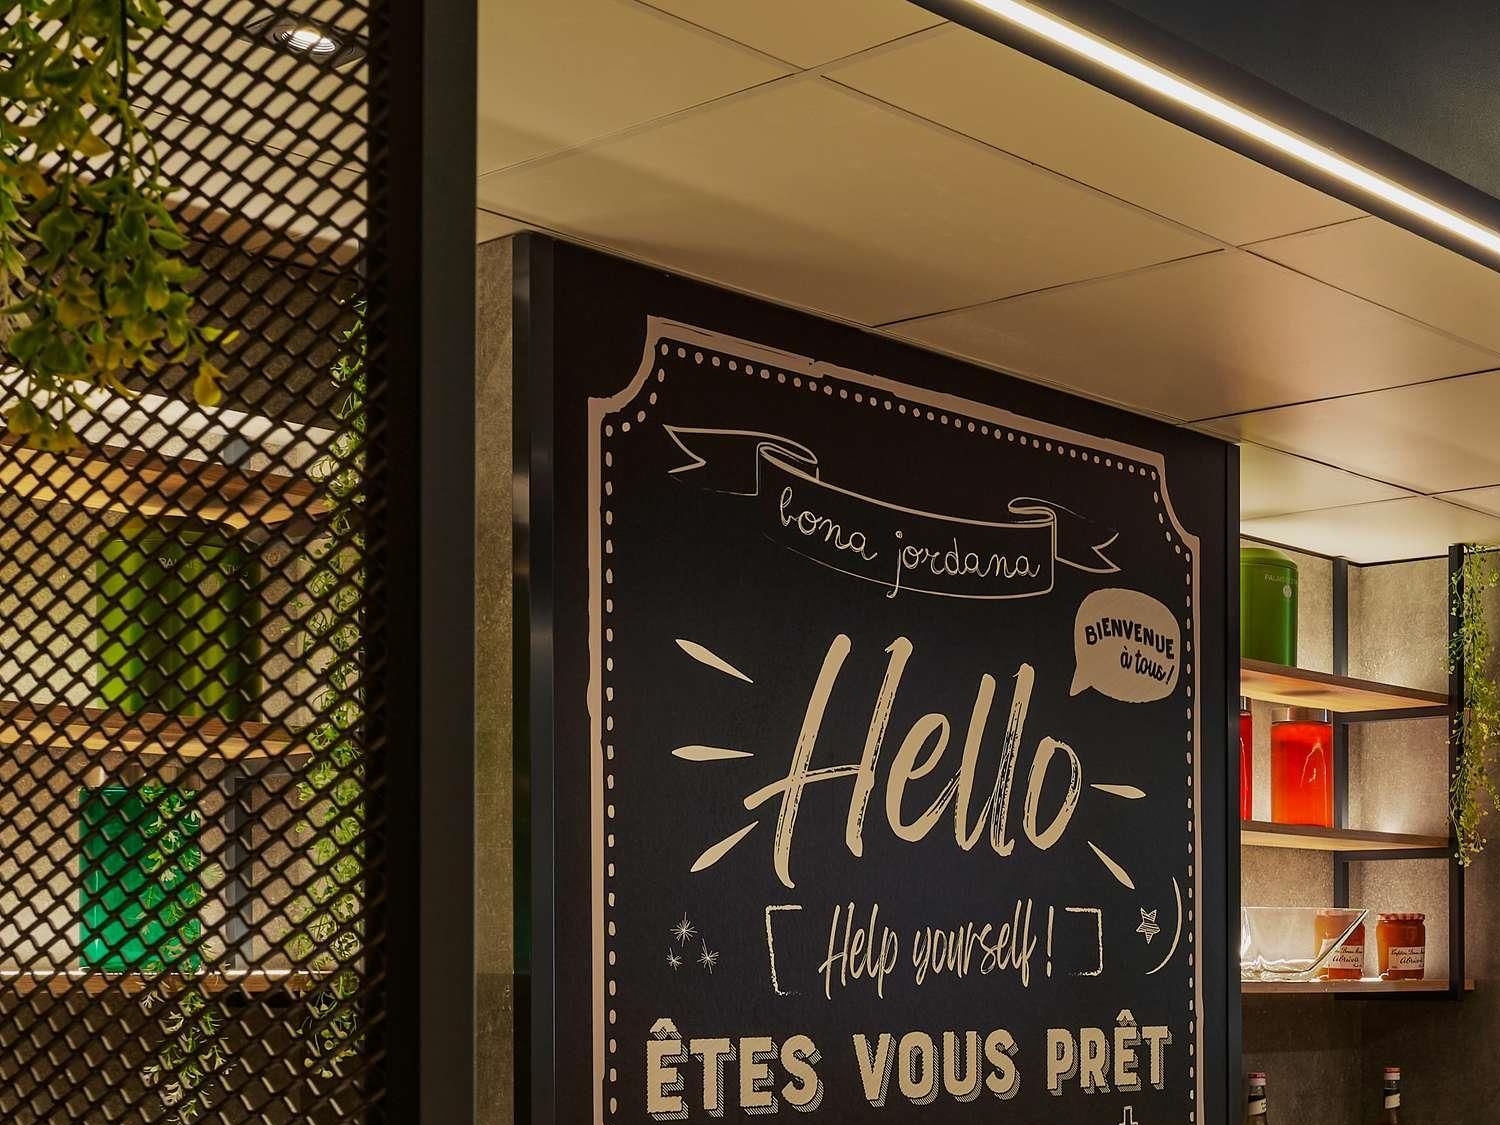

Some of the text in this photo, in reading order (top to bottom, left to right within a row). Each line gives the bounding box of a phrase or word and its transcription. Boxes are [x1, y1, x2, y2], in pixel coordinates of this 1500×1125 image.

[779, 486, 1040, 599] bona jordana
[1085, 617, 1175, 660] BIENVENUE
[1120, 645, 1133, 670] à
[743, 633, 1082, 889] Hello
[818, 901, 898, 1000] Help
[646, 1009, 1176, 1122] ÊTES VOUS PRÊT
